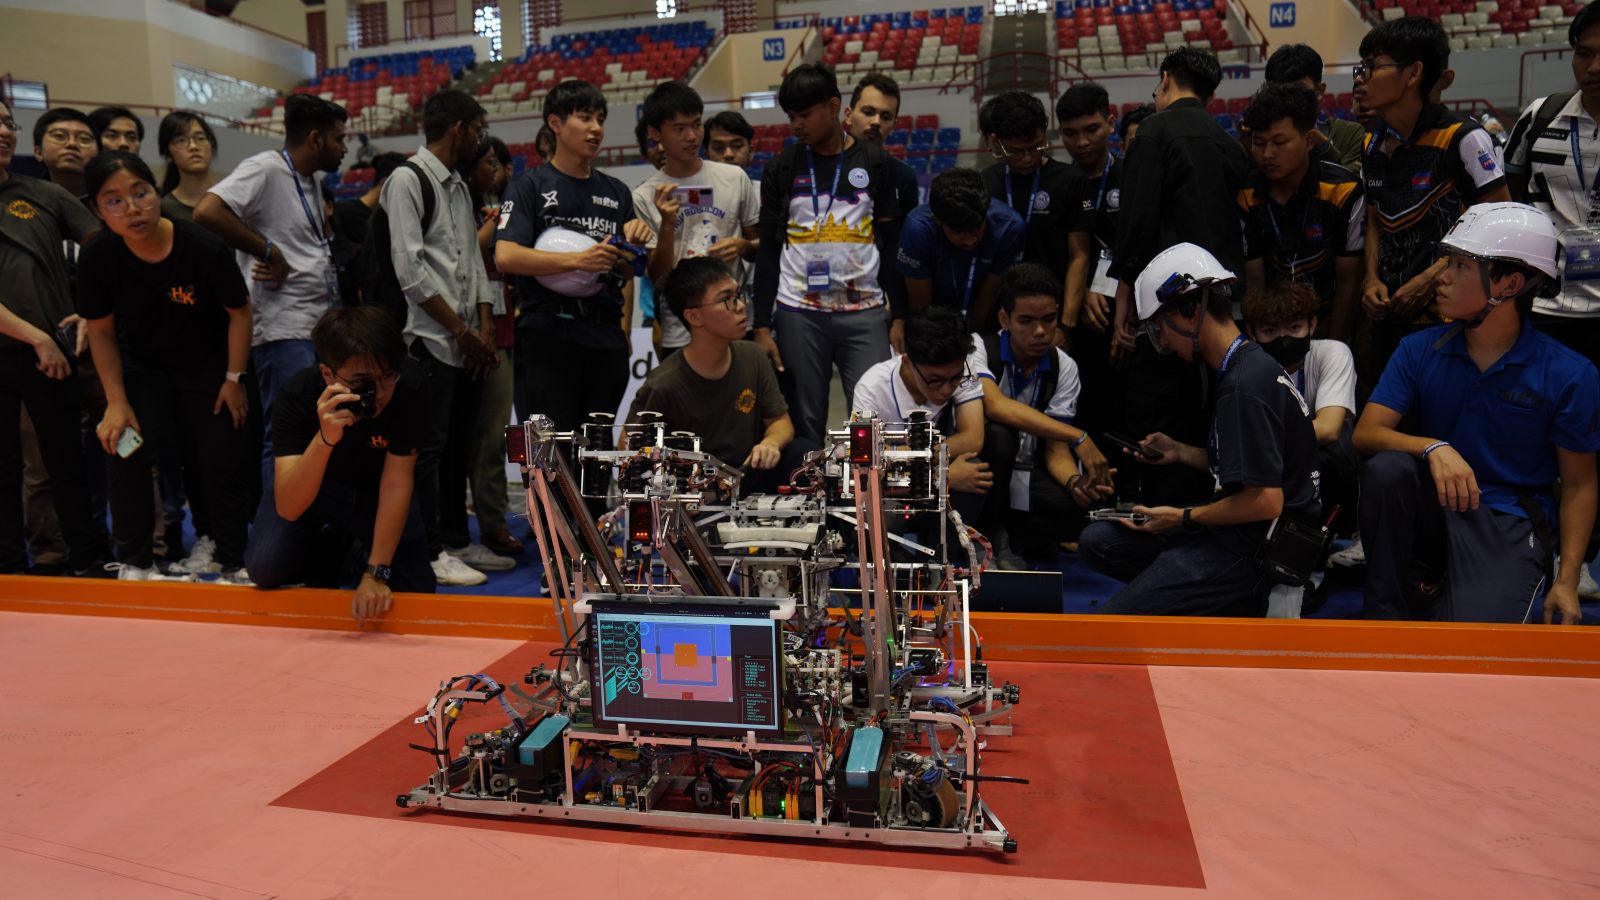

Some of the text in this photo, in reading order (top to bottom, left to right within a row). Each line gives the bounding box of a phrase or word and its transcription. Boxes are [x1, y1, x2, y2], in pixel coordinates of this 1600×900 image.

[1272, 6, 1293, 24] N4
[765, 41, 784, 57] N3
[544, 215, 617, 235] TOOHASHI
[171, 286, 195, 305] HK
